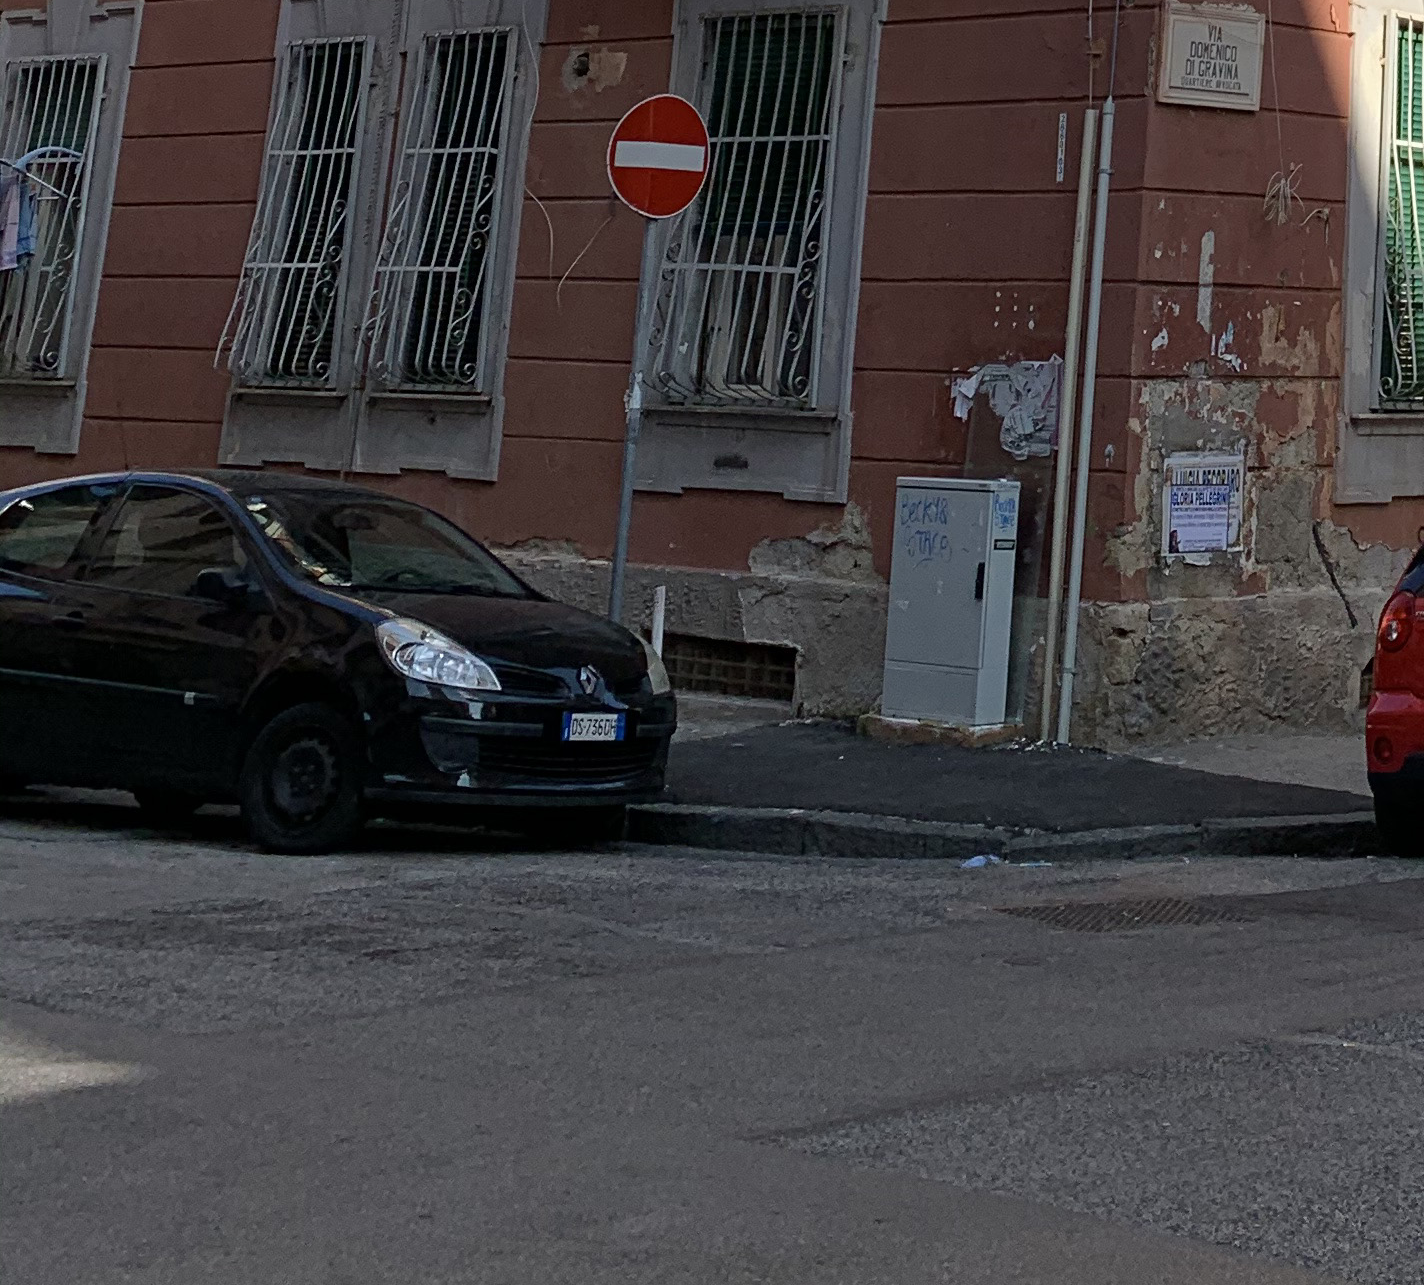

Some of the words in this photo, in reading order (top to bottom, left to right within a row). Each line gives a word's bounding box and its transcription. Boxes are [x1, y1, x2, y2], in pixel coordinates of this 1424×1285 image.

[1208, 25, 1223, 42] VIA
[1190, 41, 1238, 62] DOMENICO
[1185, 59, 1195, 76] DI
[1198, 60, 1239, 80] GRAVINA
[1172, 492, 1194, 506] GLORIA
